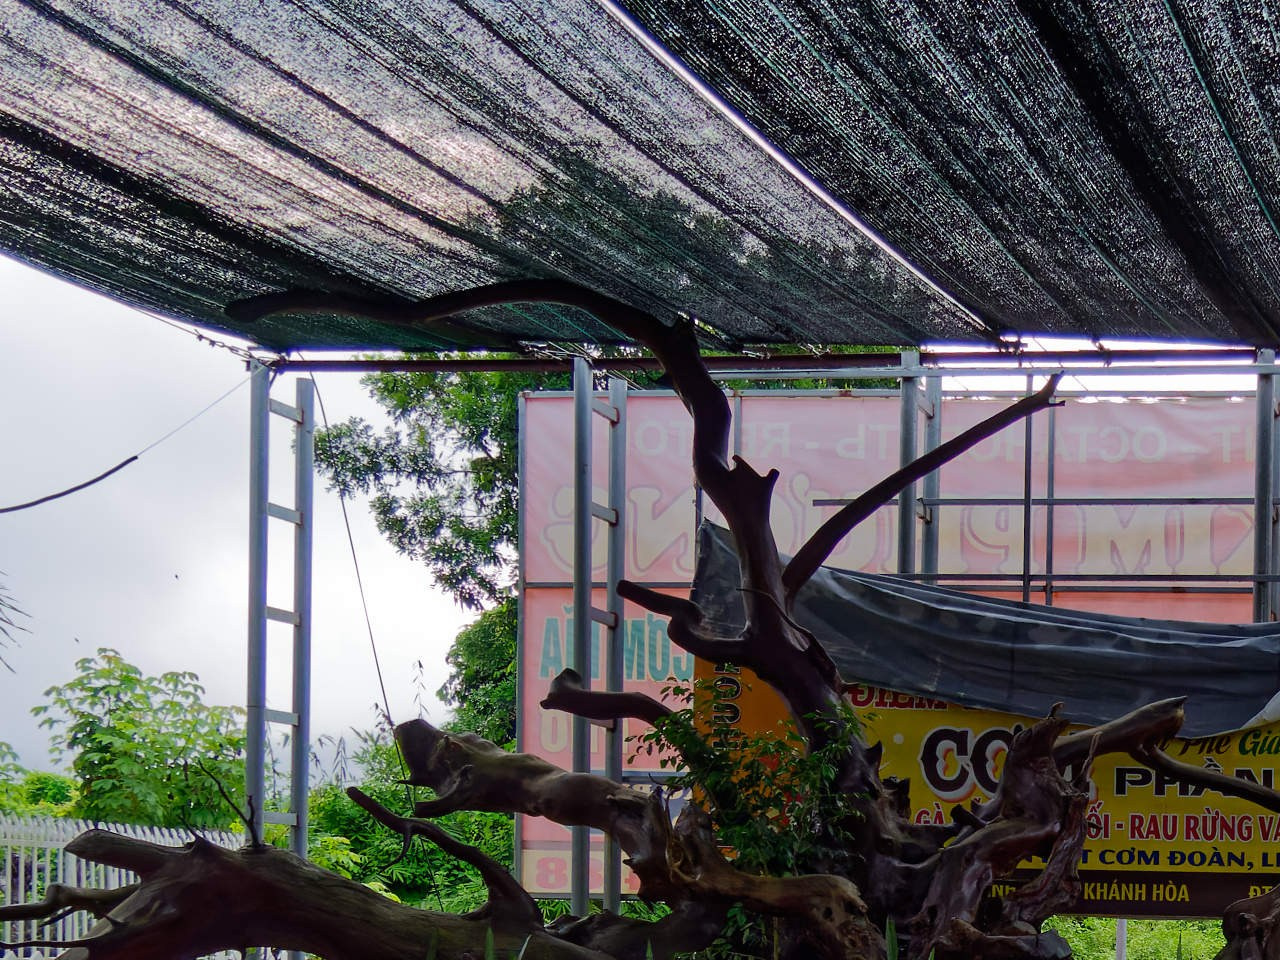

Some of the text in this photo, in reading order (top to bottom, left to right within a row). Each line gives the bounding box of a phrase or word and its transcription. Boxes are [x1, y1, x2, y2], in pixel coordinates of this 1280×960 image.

[1129, 814, 1178, 841] RAU
[1184, 806, 1254, 842] RỪNG
[1098, 847, 1161, 866] CƠM
[1167, 846, 1254, 870] ĐOÀN,
[1083, 879, 1147, 901] KHÁNH
[1152, 880, 1191, 902] HÒA
